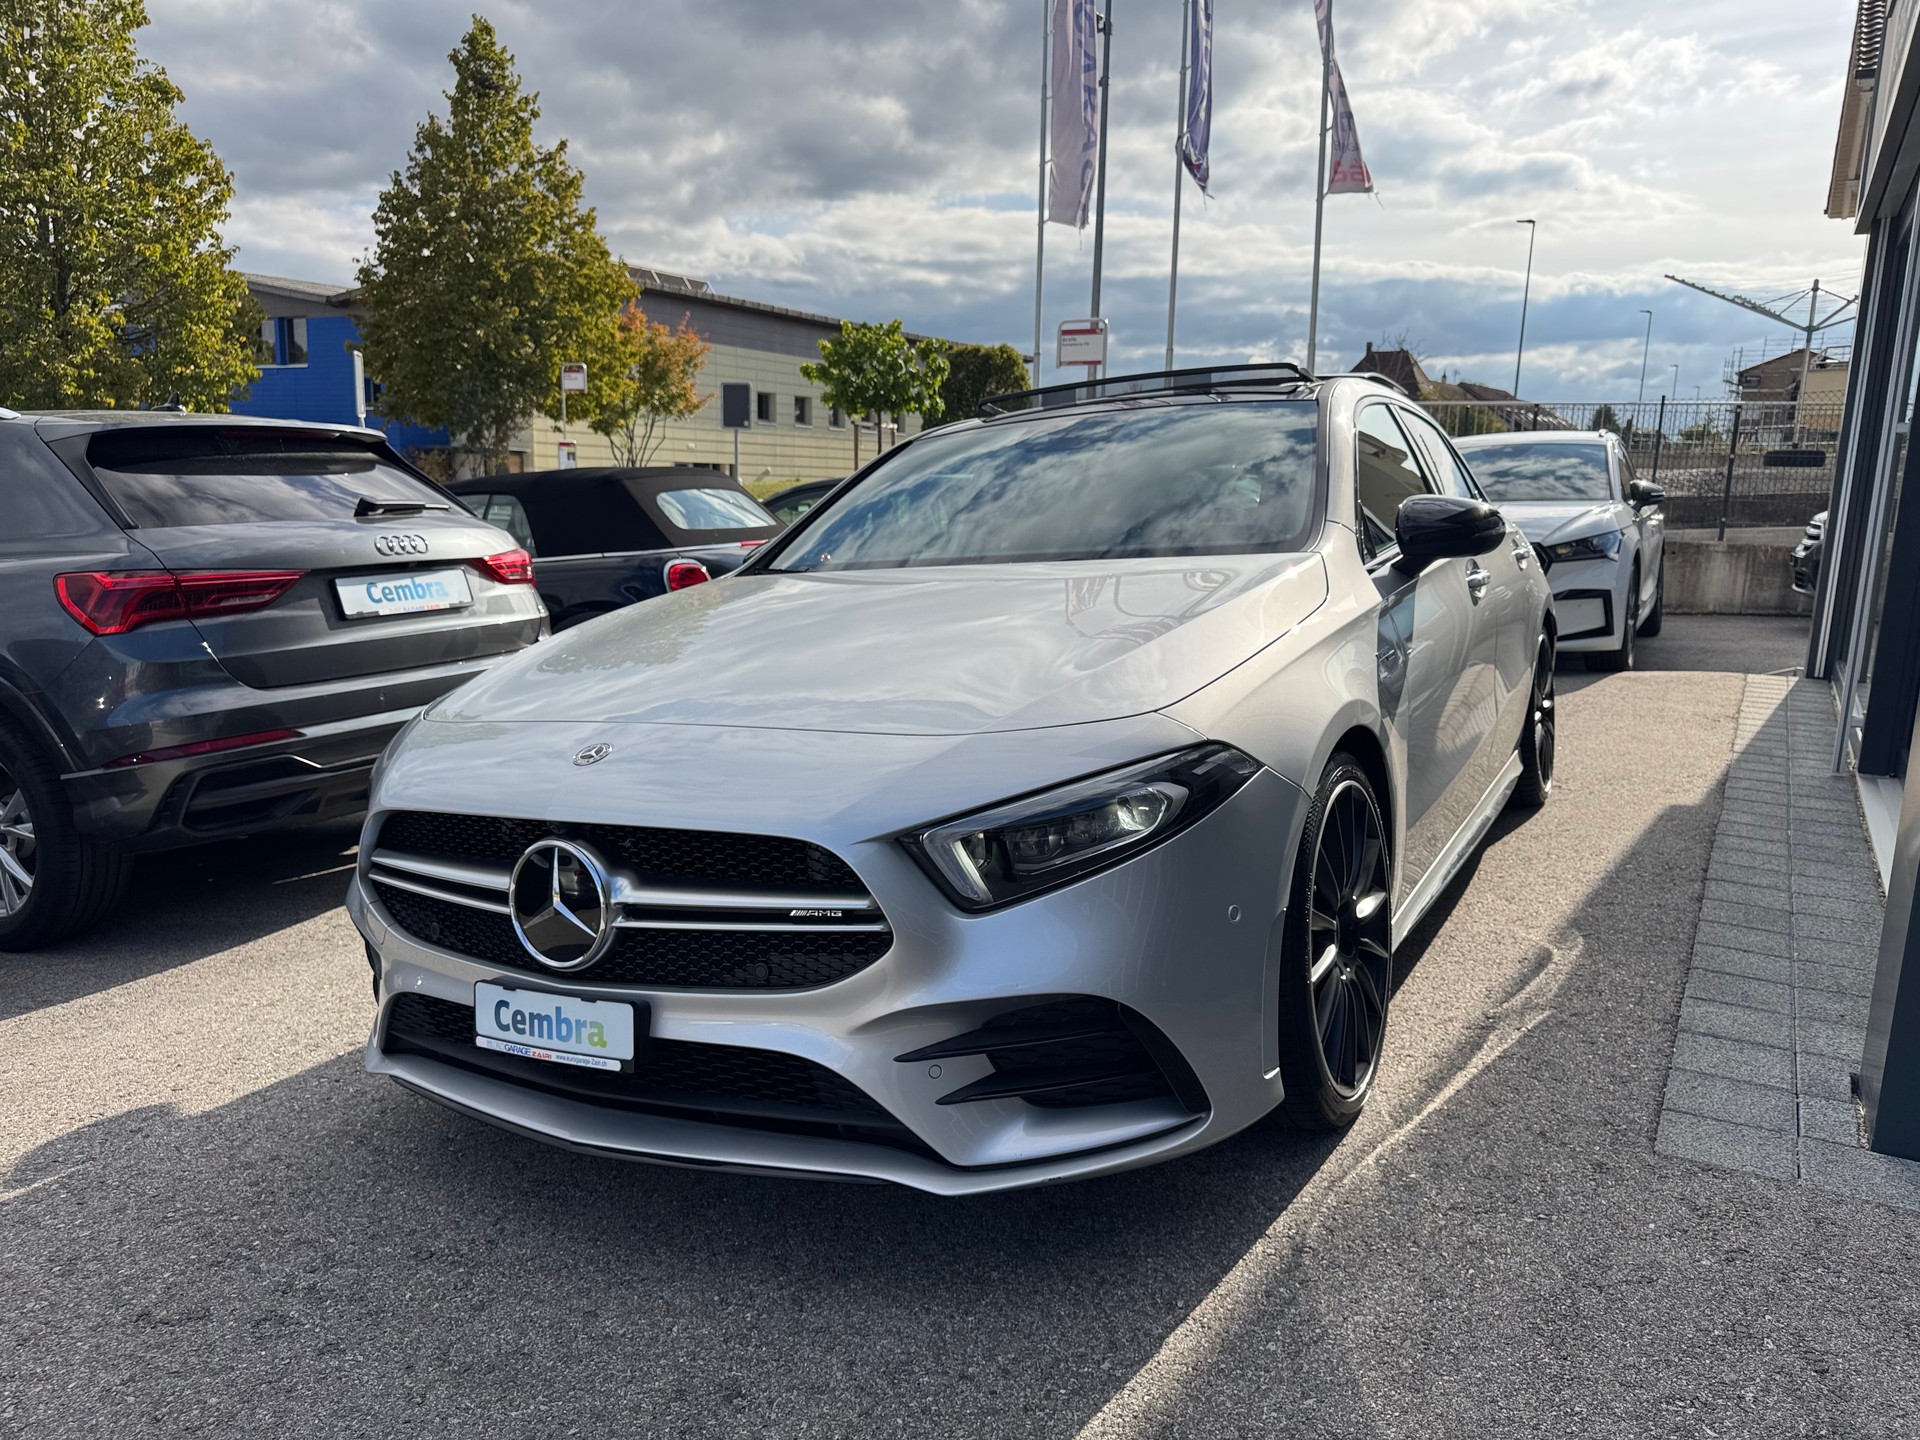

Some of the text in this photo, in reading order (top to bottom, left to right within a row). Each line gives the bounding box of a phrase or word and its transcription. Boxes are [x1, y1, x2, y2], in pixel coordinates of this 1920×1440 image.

[366, 577, 448, 604] Cembra
[494, 999, 608, 1049] Cembra
[504, 1043, 531, 1057] GARAGE
[531, 1051, 552, 1060] ZAIRI
